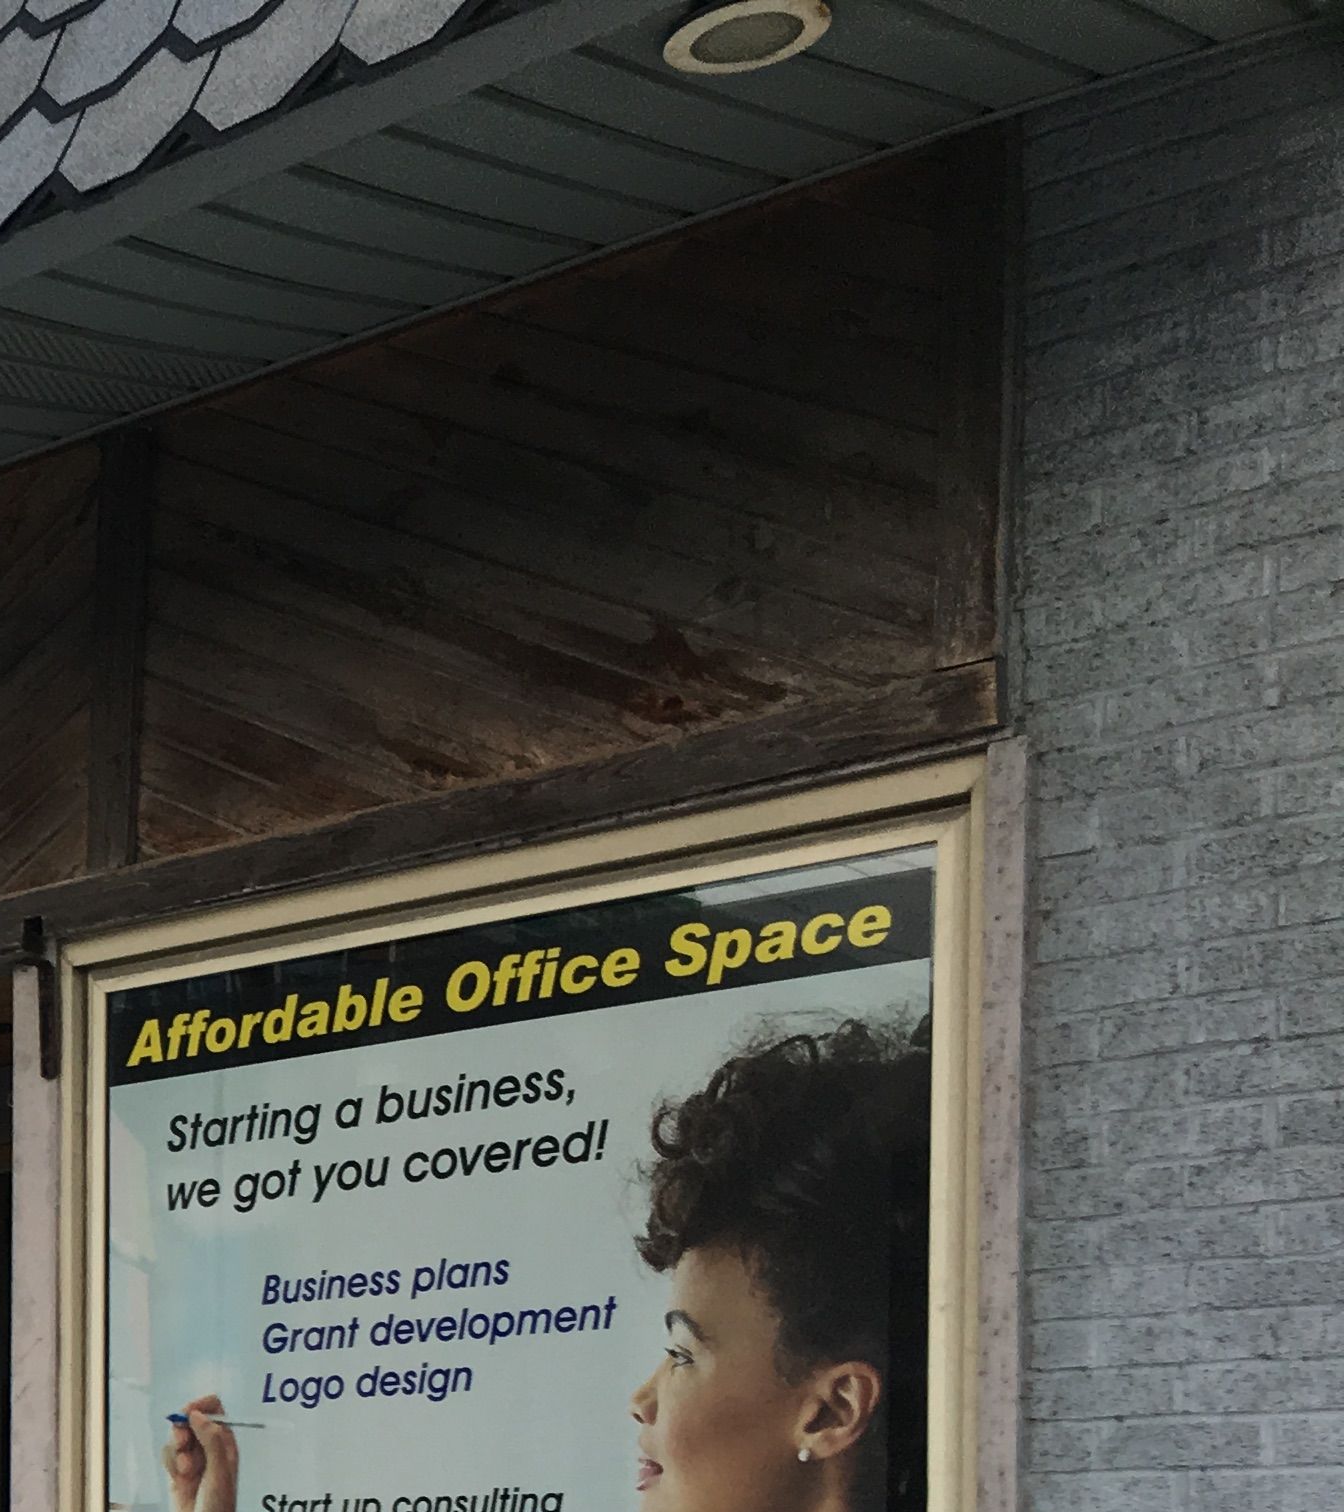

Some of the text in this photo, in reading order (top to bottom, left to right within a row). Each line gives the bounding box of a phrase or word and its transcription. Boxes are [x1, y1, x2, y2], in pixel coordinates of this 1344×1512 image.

[126, 904, 893, 1067] Affordable Office Space
[166, 1065, 578, 1152] Starting a business,
[167, 1119, 609, 1212] we got you covered!
[261, 1258, 510, 1305] Business plans
[262, 1296, 618, 1354] Grant development
[262, 1363, 473, 1410] Logo design
